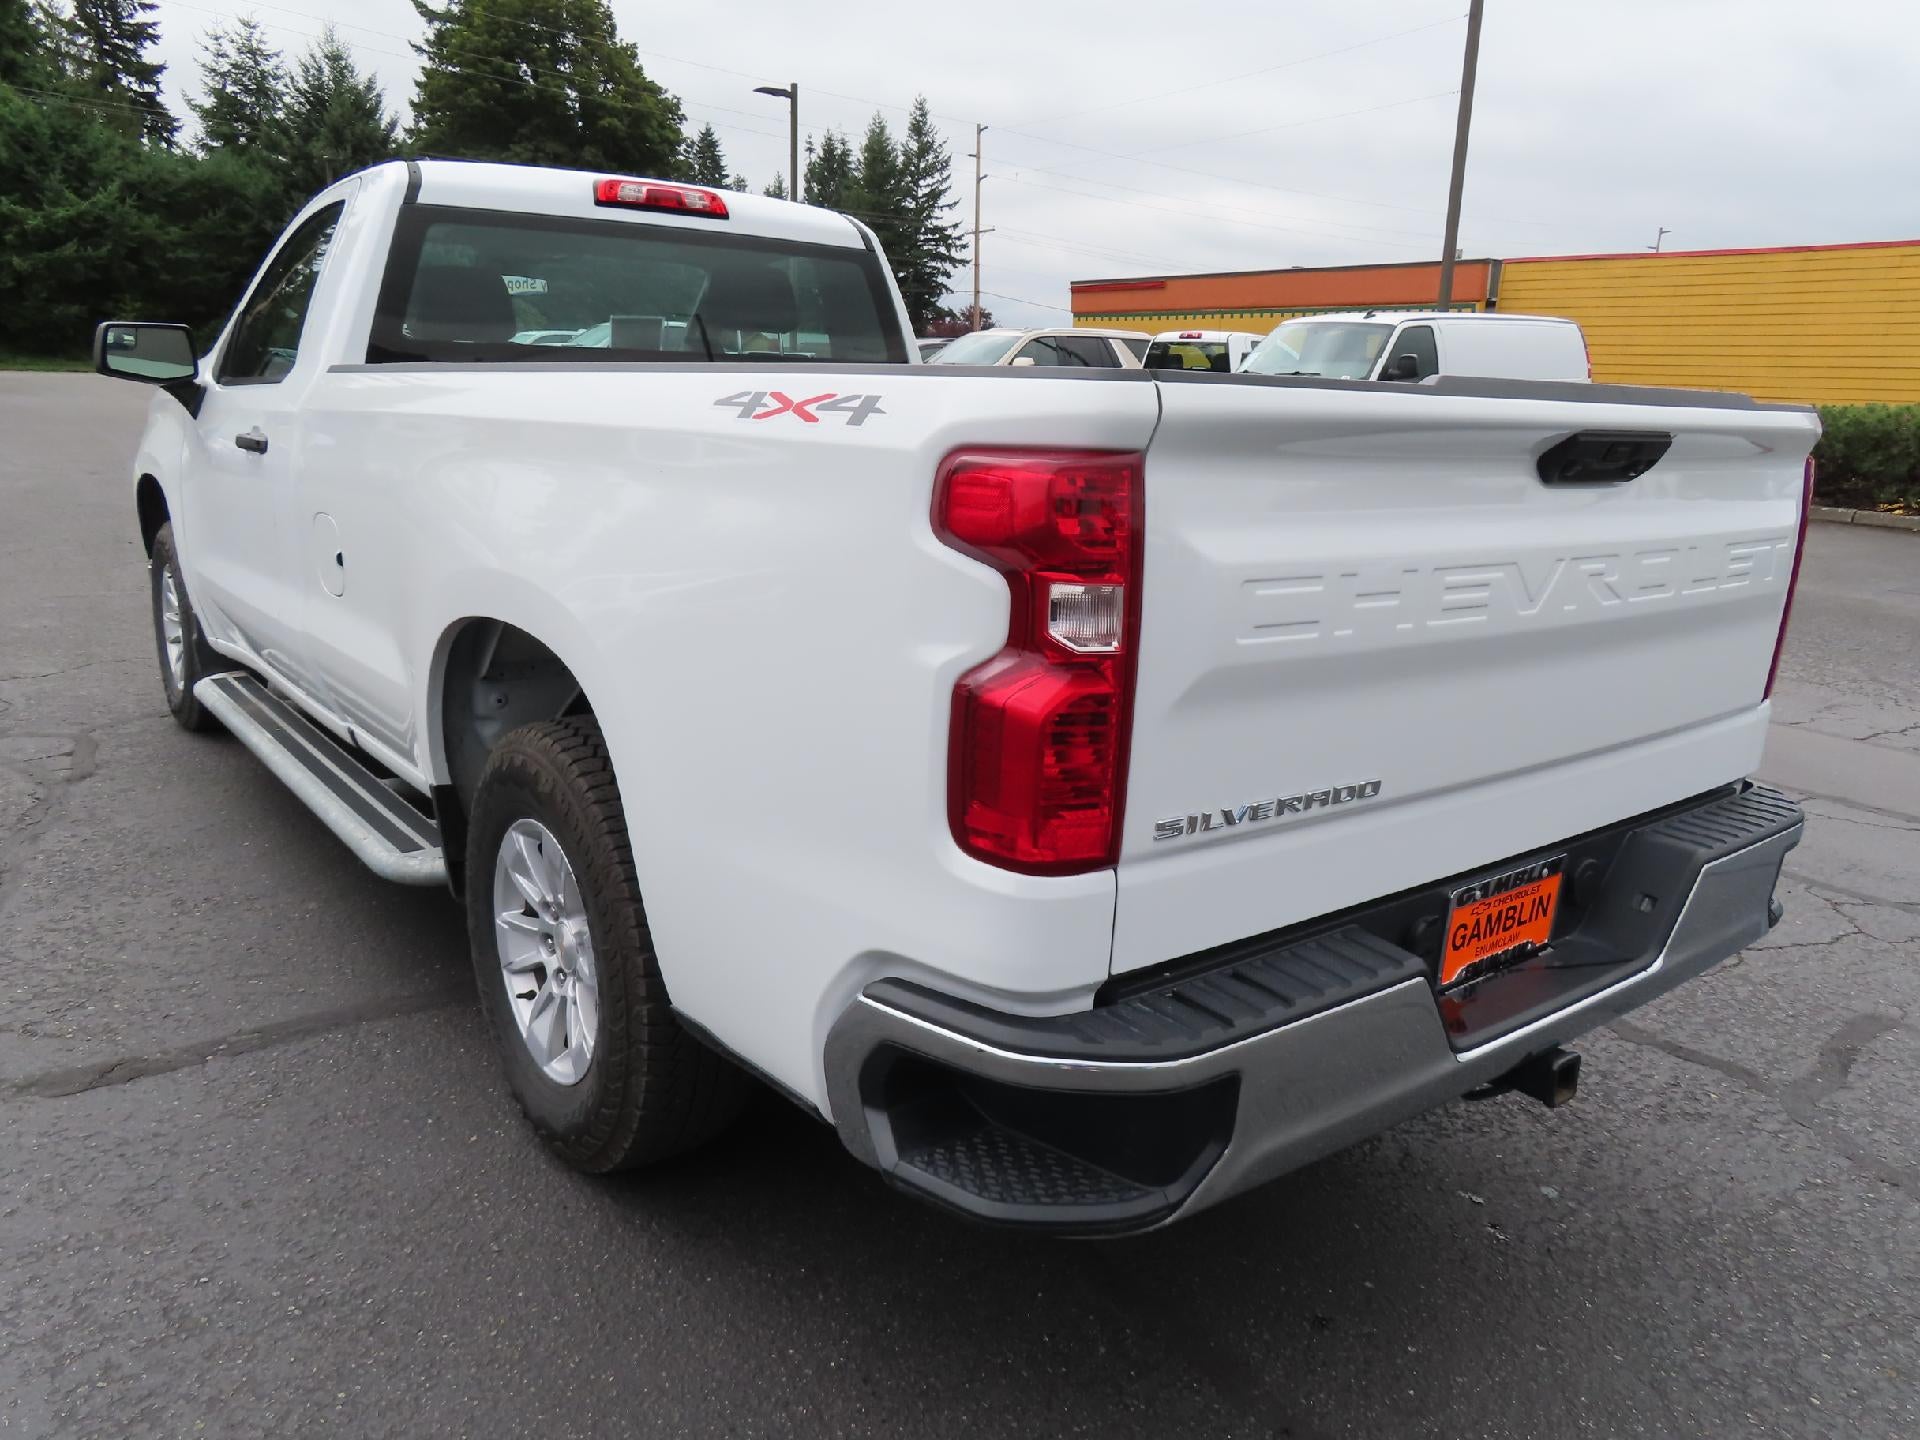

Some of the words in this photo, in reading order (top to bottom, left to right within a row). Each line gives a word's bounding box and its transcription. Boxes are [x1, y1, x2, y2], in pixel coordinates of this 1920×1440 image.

[1236, 536, 1789, 644] CHEVROLET
[1153, 778, 1382, 841] SILVERADO
[1451, 892, 1552, 952] GAMBLIN
[1492, 884, 1542, 908] CHEVROLET
[1475, 932, 1520, 957] ENUMCLAW
